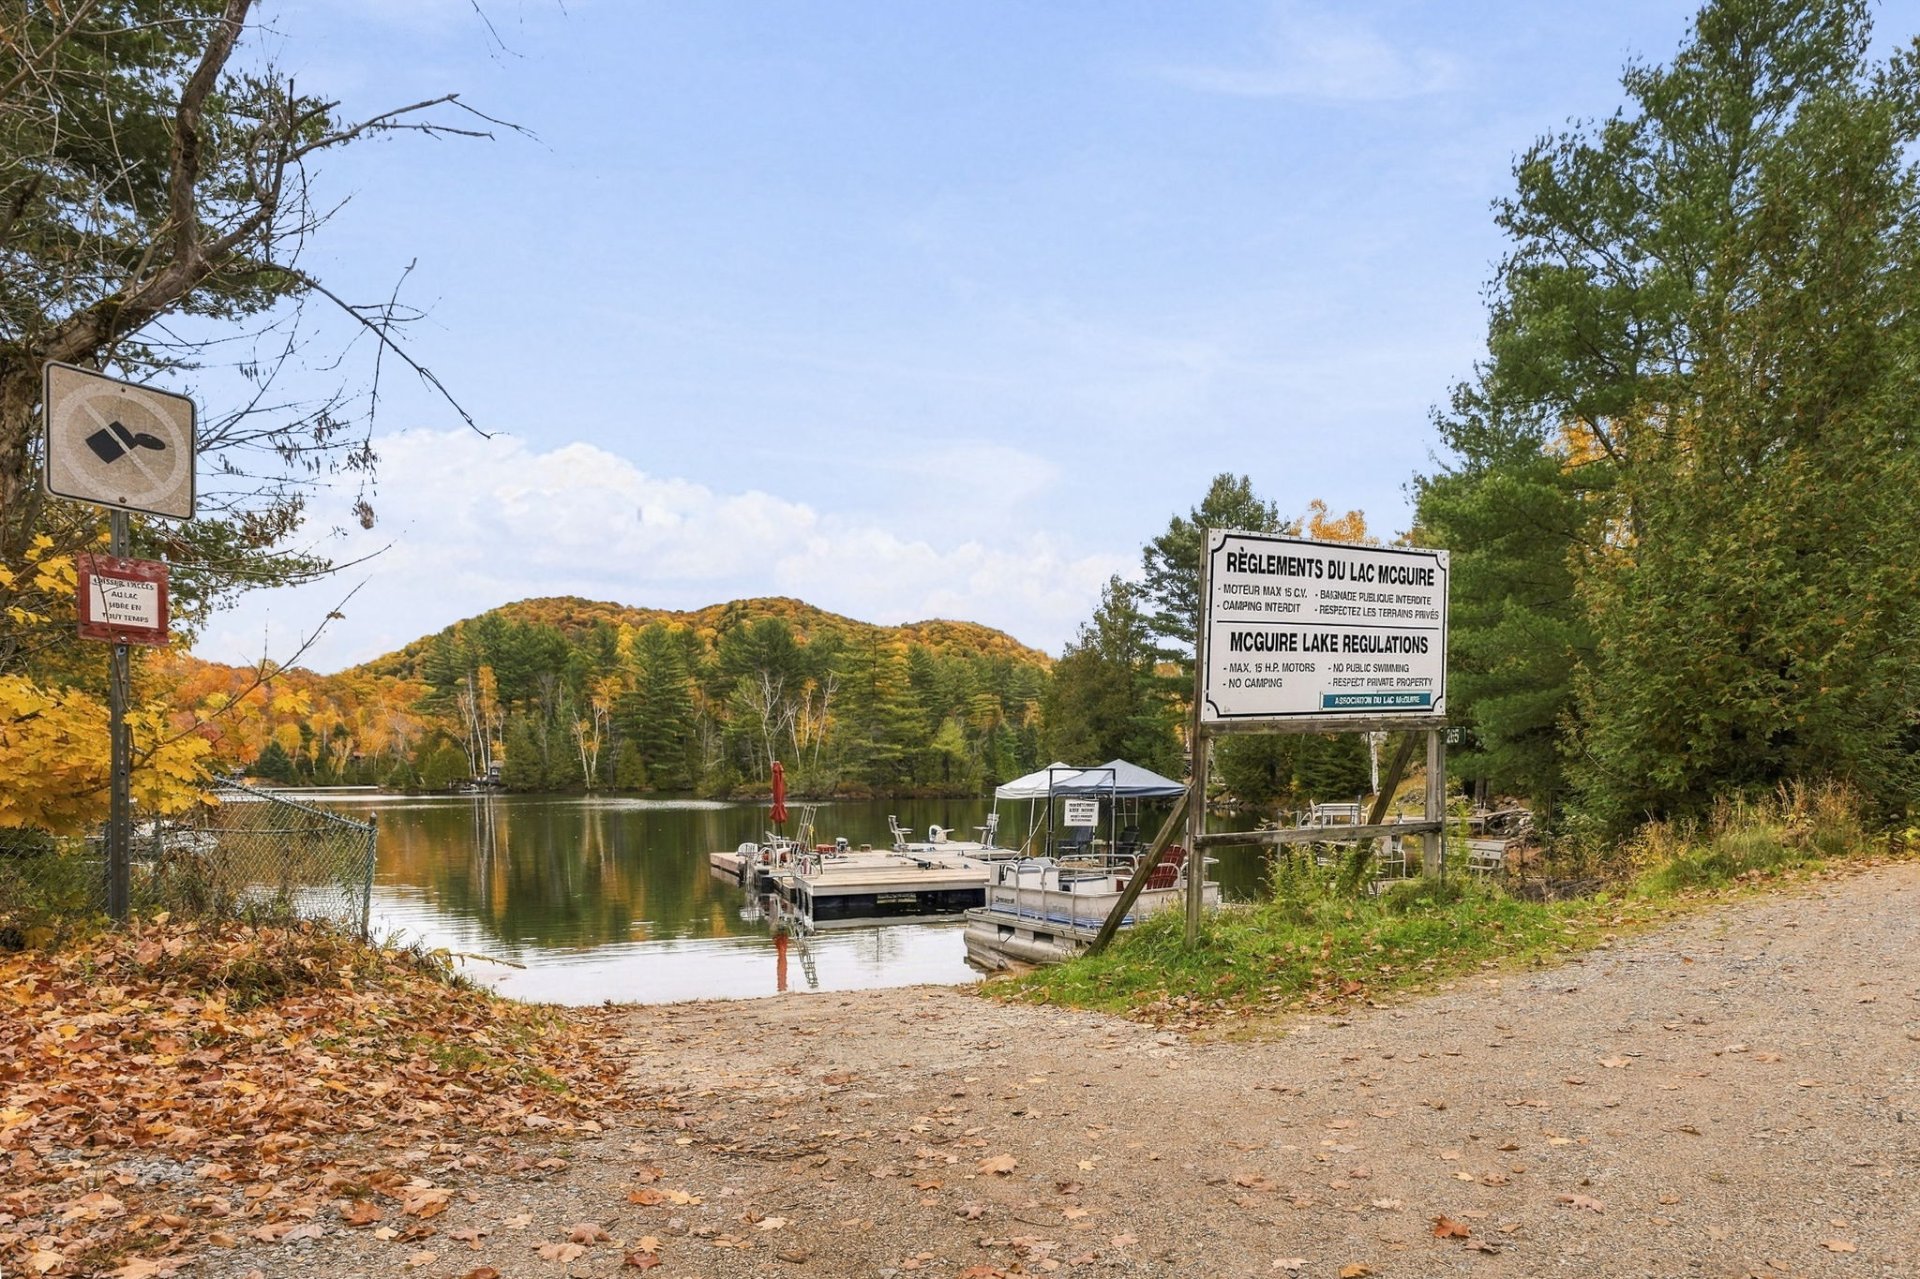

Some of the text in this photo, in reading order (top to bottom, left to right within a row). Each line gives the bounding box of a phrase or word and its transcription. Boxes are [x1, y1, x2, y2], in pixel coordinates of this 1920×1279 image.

[1227, 546, 1434, 586] RÈGLEMENTS DU LAC MCGUIRE
[1223, 584, 1307, 598] MOTEUR MAX 15 C.V.
[1320, 589, 1431, 605] BAIGNADE PUBLIQUE INTERDITE
[1223, 600, 1301, 613] CAMPING INTERDIT
[1319, 605, 1439, 620] RESPECTEZ LES TERRAINS PRIVÉS
[124, 614, 149, 623] TEMPS
[1230, 631, 1428, 654] MCGUIRE LAKE REGULATIONS
[1255, 663, 1262, 672] 15
[1265, 663, 1280, 673] H.P.
[1282, 662, 1315, 672] MOTORS
[1332, 663, 1409, 672] NO PUBLIC SWIMMING
[1228, 678, 1283, 688] NO CAMPING
[1333, 677, 1433, 687] RESPECT PRIVATE PROPERTY
[1334, 696, 1371, 705] ASSOCIATION
[1373, 696, 1382, 704] DU
[1383, 696, 1394, 704] LAC
